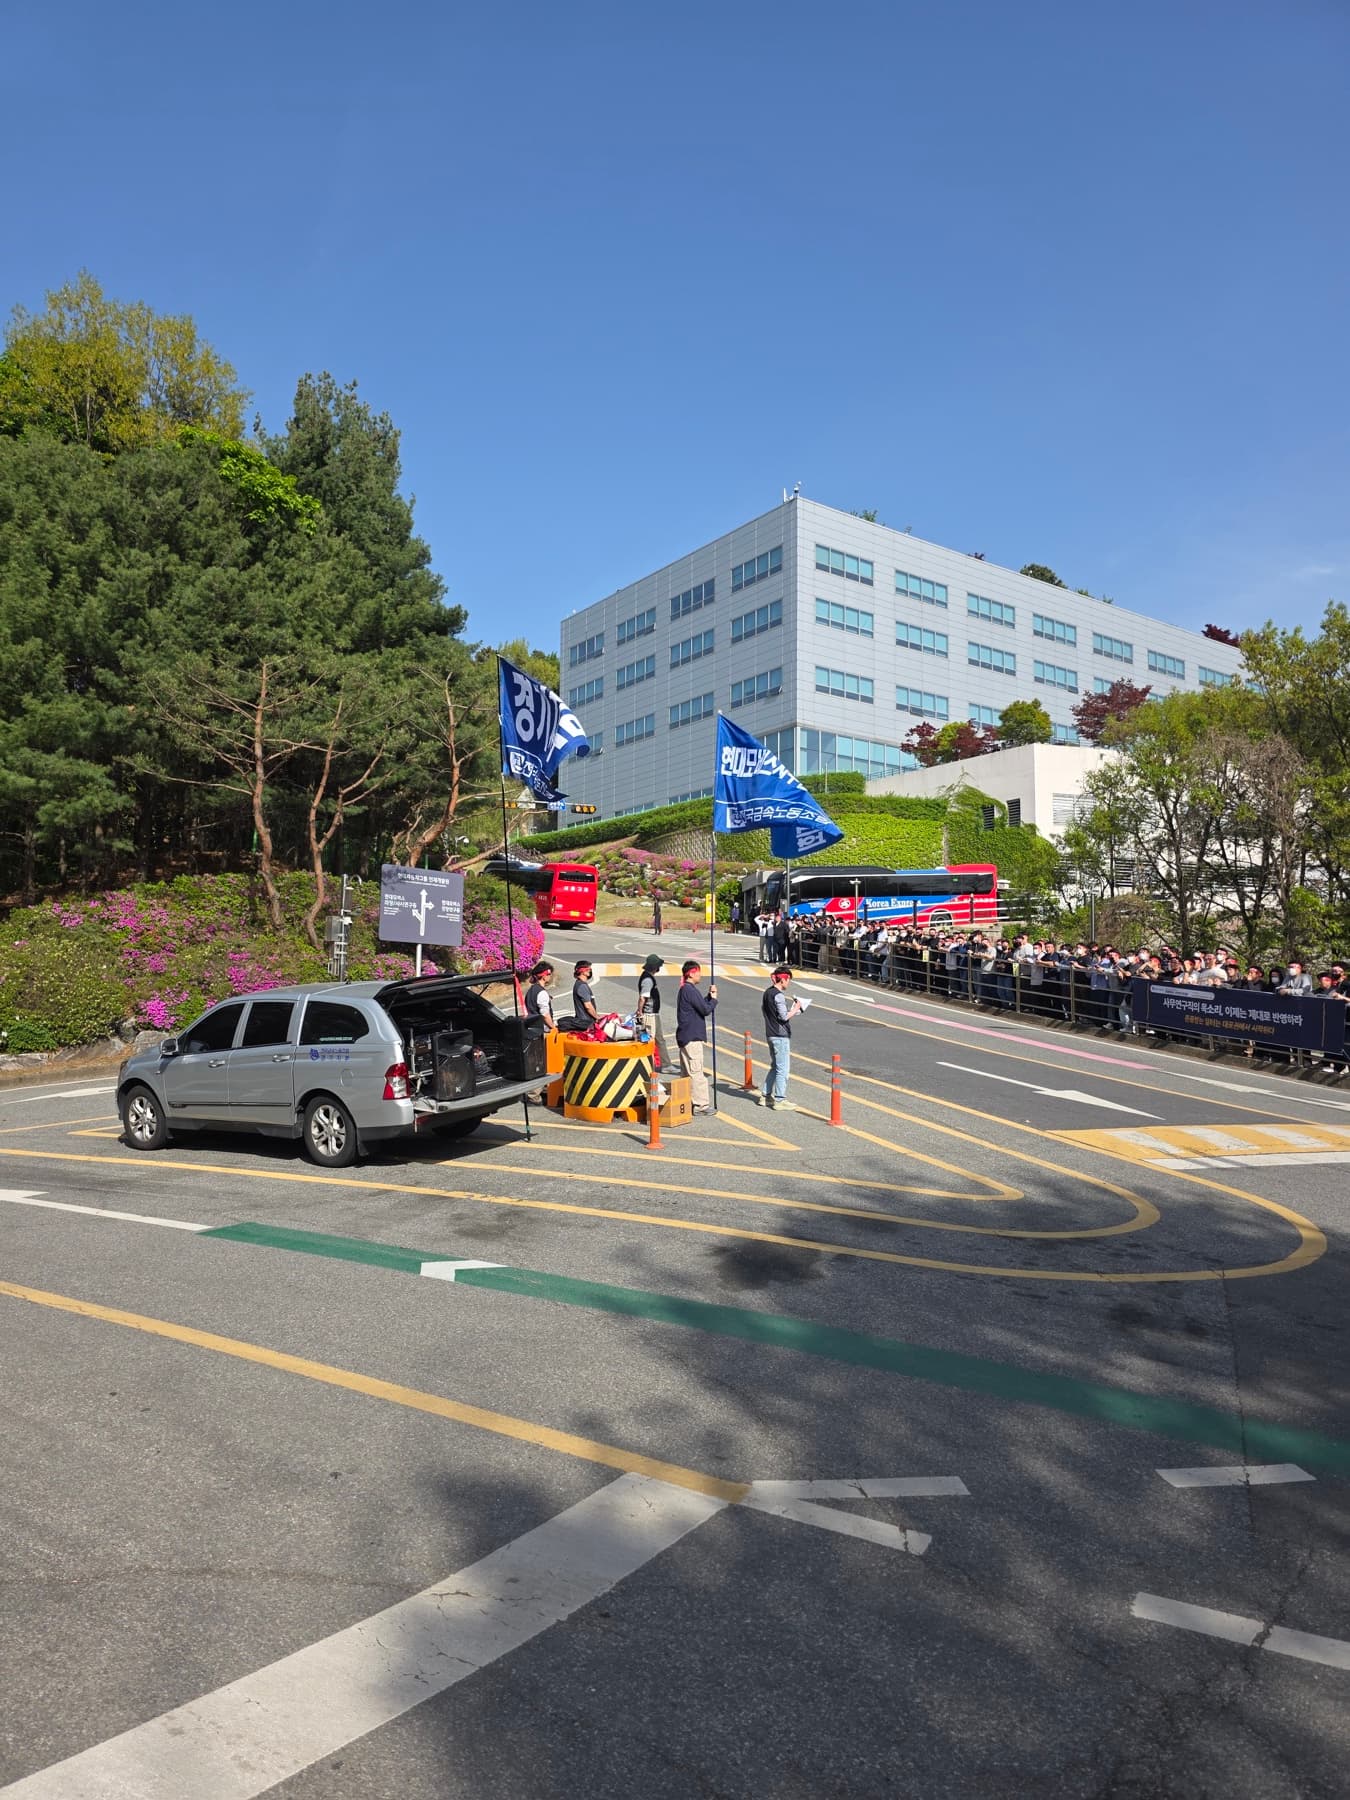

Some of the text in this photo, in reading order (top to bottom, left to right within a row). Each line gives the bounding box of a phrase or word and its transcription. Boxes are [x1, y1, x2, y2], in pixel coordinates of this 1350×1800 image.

[865, 898, 922, 908] Korea Expres
[1163, 997, 1200, 1013] 사무연구직의
[1224, 1006, 1247, 1019] 이제는
[1248, 1009, 1272, 1021] 제대로
